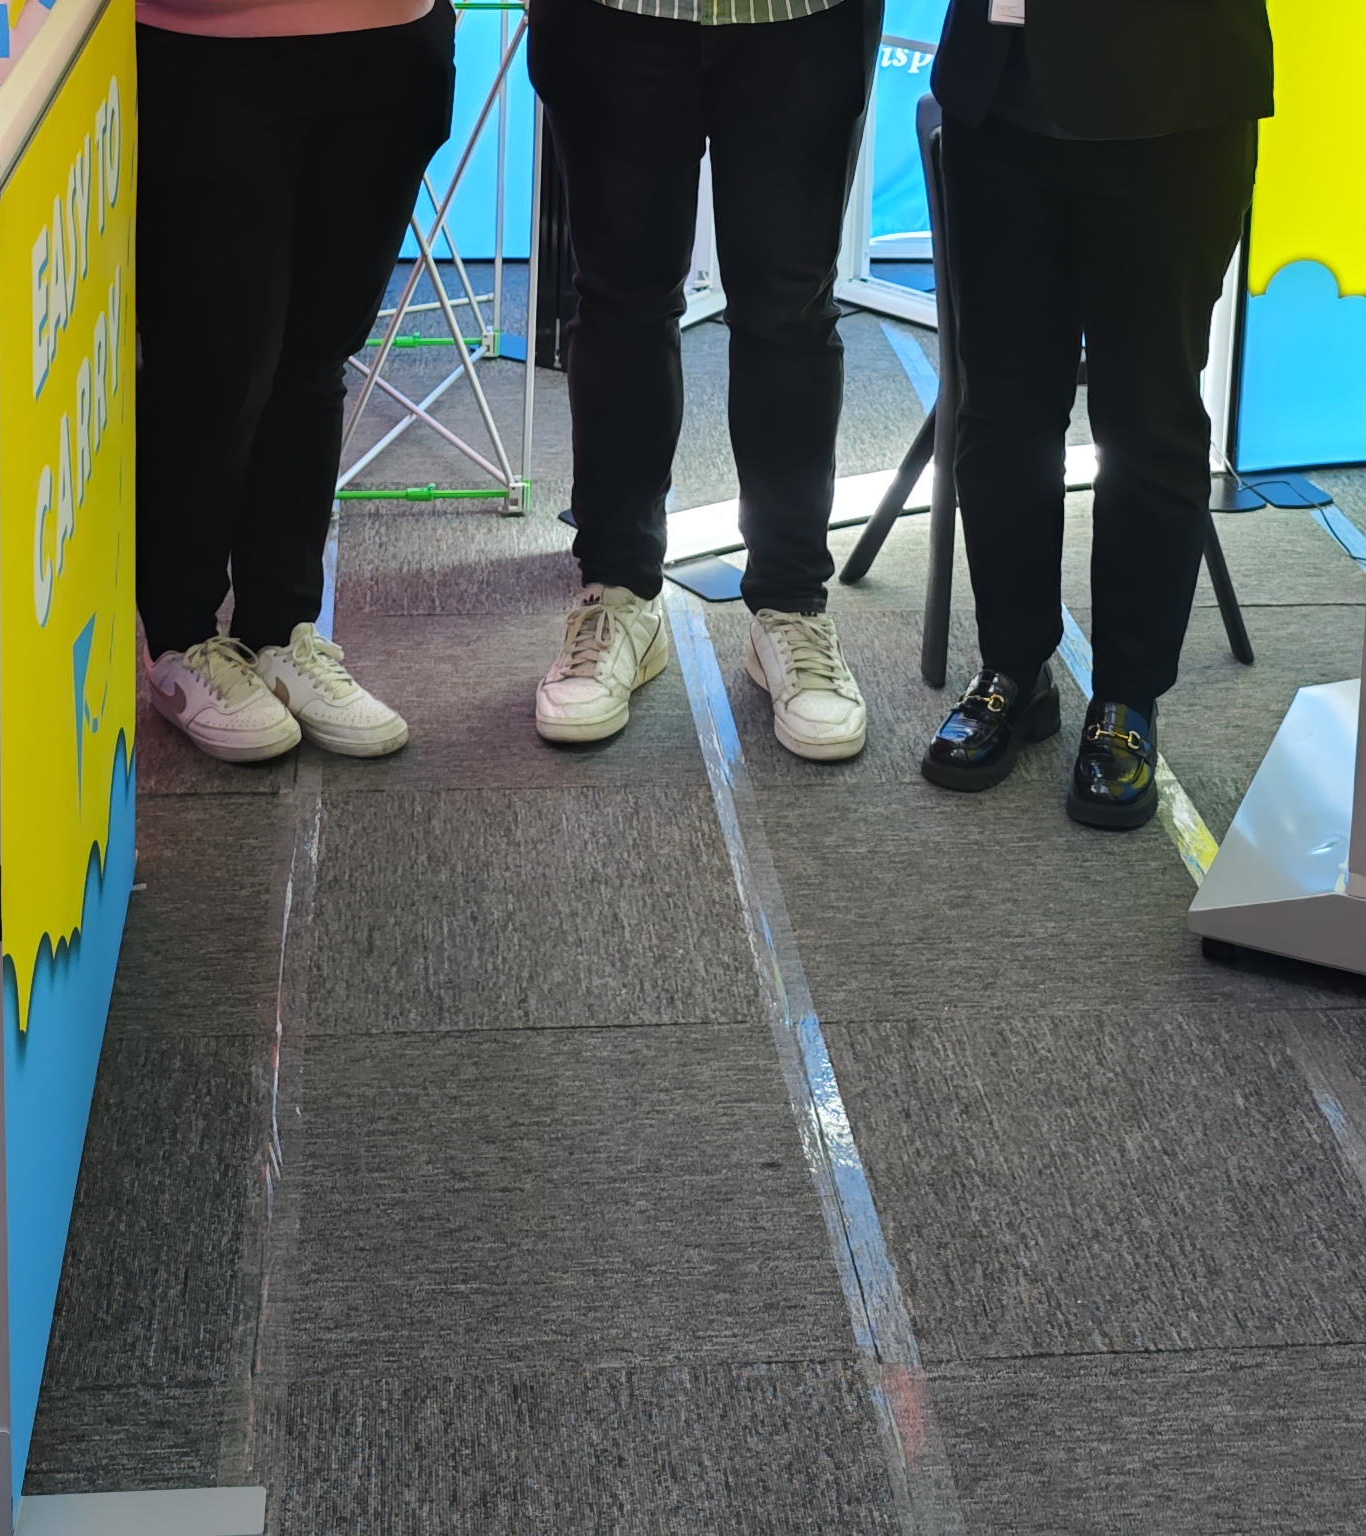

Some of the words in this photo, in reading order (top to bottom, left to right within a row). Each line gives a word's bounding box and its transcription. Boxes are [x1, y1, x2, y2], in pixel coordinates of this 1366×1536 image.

[32, 133, 92, 402] EASY
[95, 74, 121, 235] TO
[34, 265, 122, 628] CARRY
